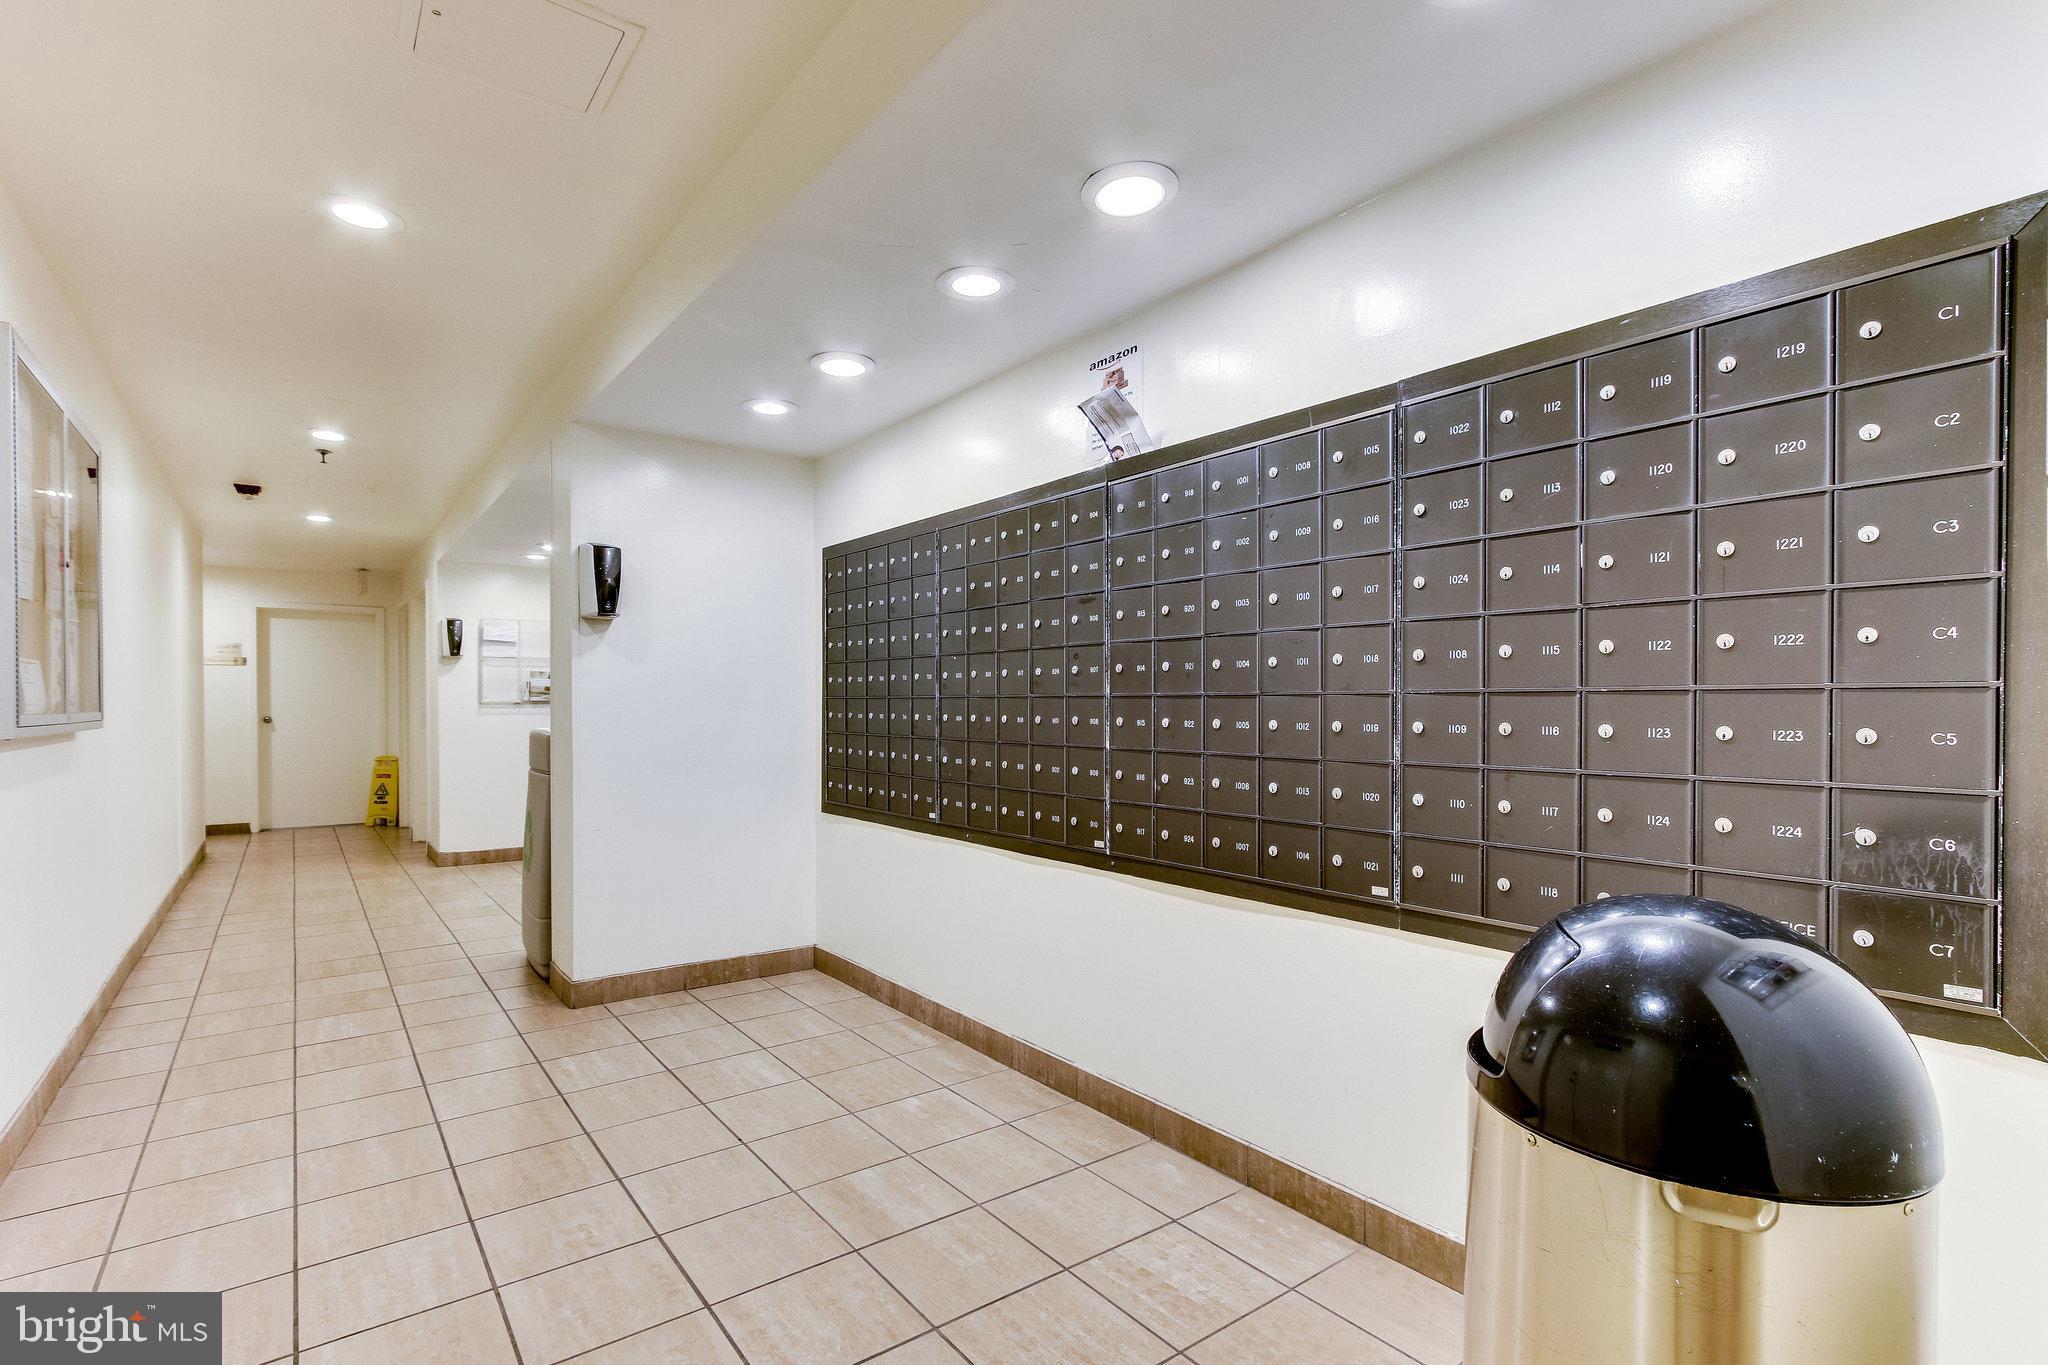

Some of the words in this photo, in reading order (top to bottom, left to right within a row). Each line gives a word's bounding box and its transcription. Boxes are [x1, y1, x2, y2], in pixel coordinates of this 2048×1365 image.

[1937, 304, 1960, 320] C1
[1776, 342, 1806, 359] 1219
[1089, 345, 1138, 371] amazon
[1651, 374, 1672, 389] 1119
[1543, 400, 1562, 414] 1112
[1933, 412, 1961, 428] C2
[1449, 422, 1470, 436] 1022
[1364, 444, 1380, 456] 1015
[1775, 439, 1807, 455] 1220
[1295, 460, 1311, 472] 1008
[1649, 462, 1673, 477] 1120
[1236, 476, 1249, 485] 1001
[1543, 482, 1561, 494] 1113
[1449, 498, 1470, 510] 1023
[1363, 514, 1380, 525] 1016
[1295, 526, 1312, 537] 1009
[1932, 519, 1960, 534] C3
[1235, 536, 1250, 546] 1002
[1776, 536, 1803, 550] 1221
[1650, 551, 1670, 564] 1121
[1543, 563, 1561, 575] 1114
[1449, 573, 1469, 585] 1024
[1364, 584, 1379, 594] 1017
[1296, 591, 1311, 601] 1010
[1184, 604, 1195, 612] 920
[1235, 598, 1250, 607] 1003
[1932, 626, 1959, 640] C4
[1648, 639, 1672, 651] 1122
[1773, 633, 1805, 646] 1222
[1449, 649, 1468, 659] 1108
[1542, 644, 1560, 656] 1115
[1236, 659, 1250, 668] 1004
[1296, 657, 1309, 666] 1011
[1363, 654, 1380, 663] 1018
[1235, 721, 1250, 730] 1005
[1296, 722, 1310, 731] 1012
[1363, 723, 1379, 733] 1019
[1448, 724, 1467, 734] 1109
[1541, 725, 1560, 736] 1116
[1647, 727, 1671, 739] 1123
[1772, 729, 1804, 742] 1223
[1930, 732, 1958, 746] C5
[1184, 777, 1194, 786] 923
[1235, 781, 1250, 791] 1006
[1296, 786, 1310, 796] 1013
[1362, 792, 1380, 802] 1020
[1450, 798, 1466, 809] 1110
[1541, 806, 1559, 817] 1117
[1647, 814, 1671, 827] 1124
[1772, 824, 1803, 838] 1224
[1184, 834, 1194, 843] 924
[1235, 842, 1250, 852] 1007
[1928, 838, 1957, 852] C6
[1296, 851, 1310, 861] 1014
[1363, 861, 1379, 871] 1021
[1450, 873, 1464, 884] 1111
[1540, 886, 1559, 898] 1118
[1928, 943, 1955, 958] C7
